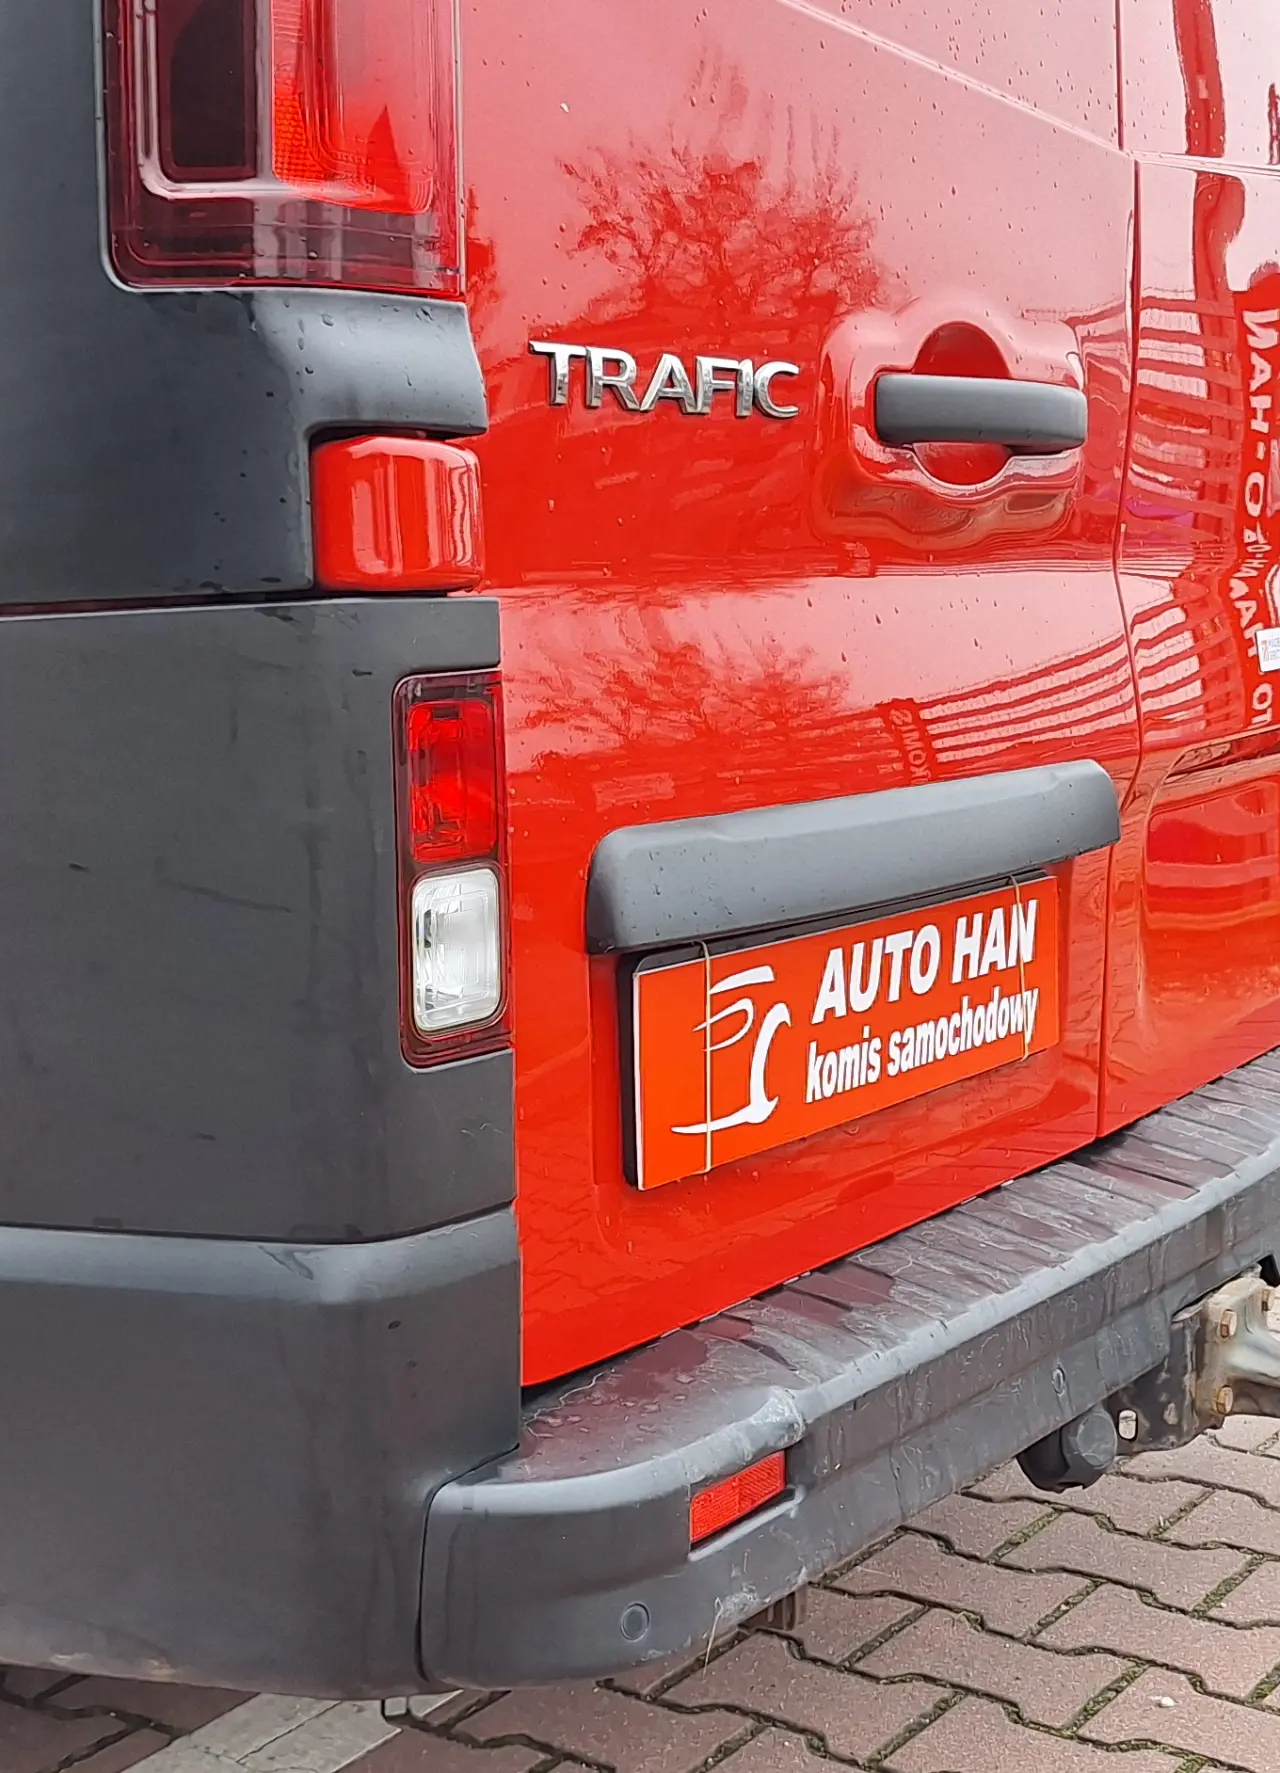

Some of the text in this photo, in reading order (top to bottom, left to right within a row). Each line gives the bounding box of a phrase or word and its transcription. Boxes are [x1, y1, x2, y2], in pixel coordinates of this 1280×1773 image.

[529, 340, 800, 419] TRAFIC
[812, 899, 1038, 1024] AUTO HAN
[805, 985, 1040, 1104] komis samochodowy
